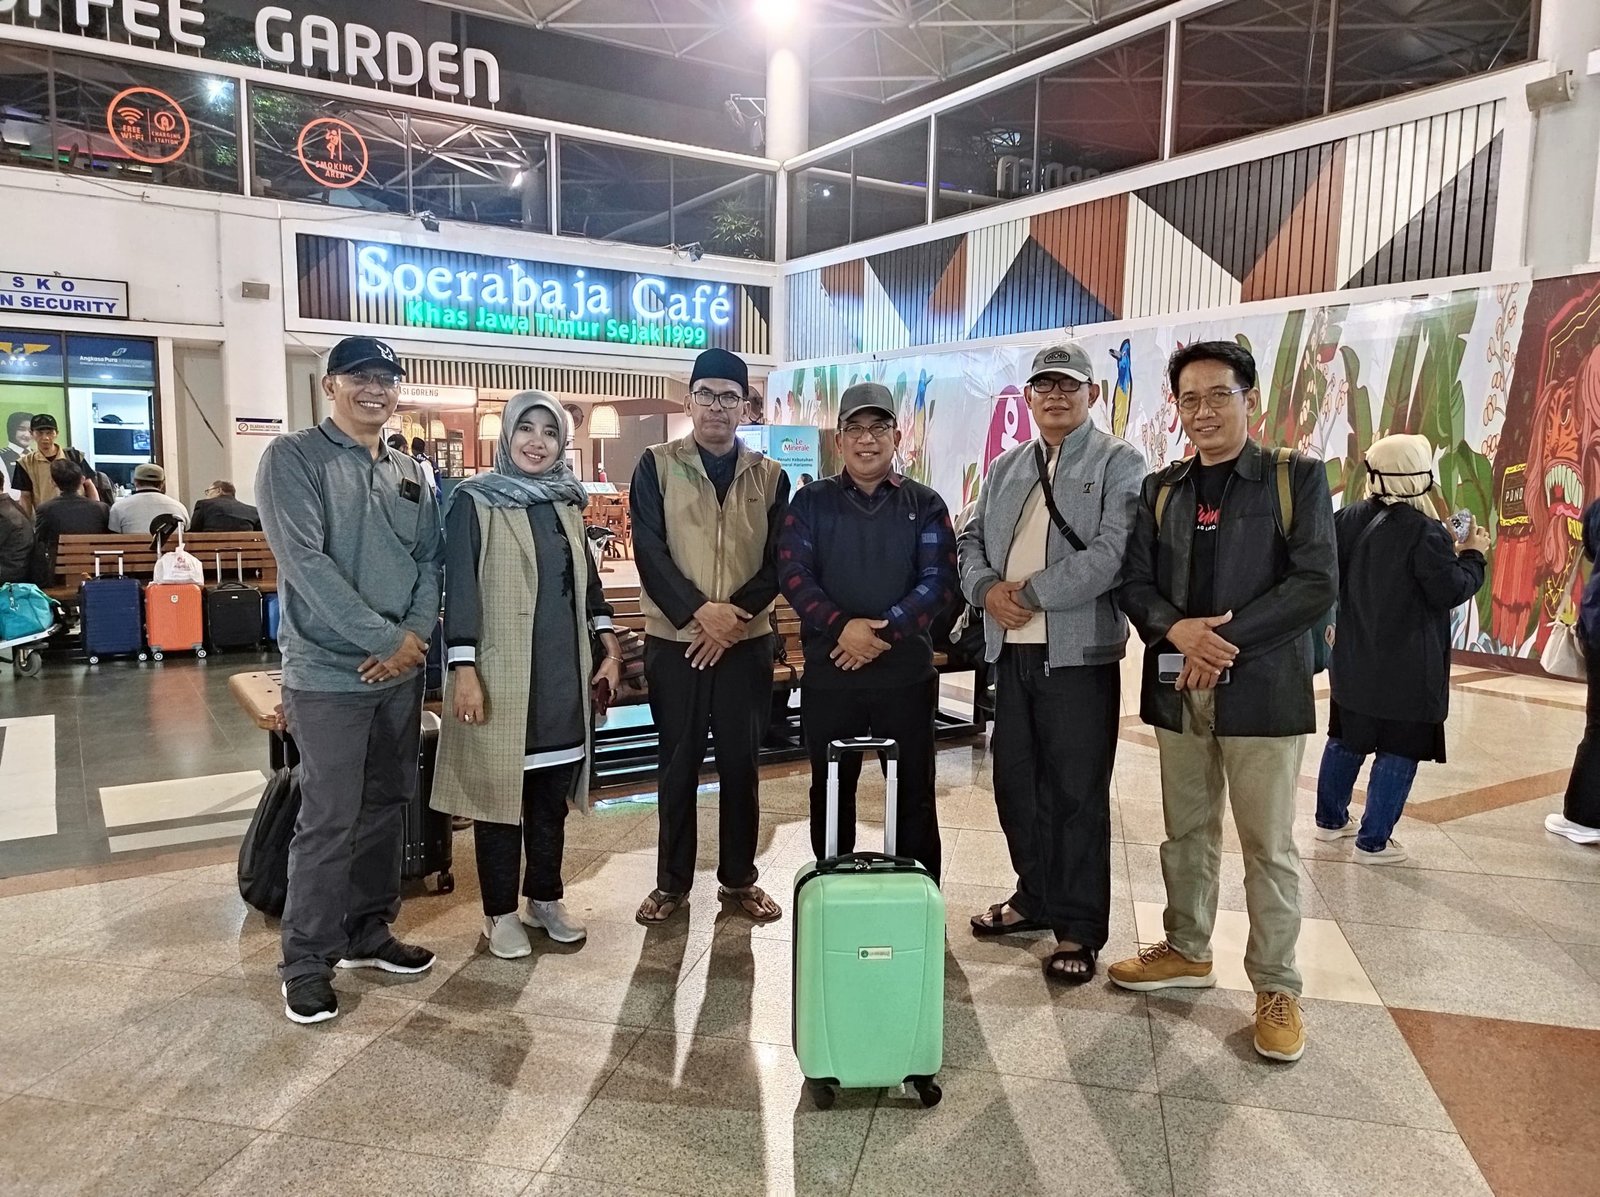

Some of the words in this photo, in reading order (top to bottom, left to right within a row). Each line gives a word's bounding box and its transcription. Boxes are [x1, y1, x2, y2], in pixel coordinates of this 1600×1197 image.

[255, 6, 500, 103] GARDEN
[122, 124, 141, 133] FREE
[315, 160, 353, 172] SMOKING
[325, 170, 345, 179] AREA
[20, 296, 117, 314] SECURITY
[633, 277, 731, 325] Café
[408, 300, 468, 326] Khas
[475, 306, 529, 332] Jawa
[534, 312, 600, 337] Timur
[606, 318, 661, 344] Sejak
[663, 323, 706, 345] 1999
[400, 387, 409, 396] SI
[411, 388, 439, 397] GORENG
[795, 438, 803, 446] Le
[784, 444, 809, 452] Minerale
